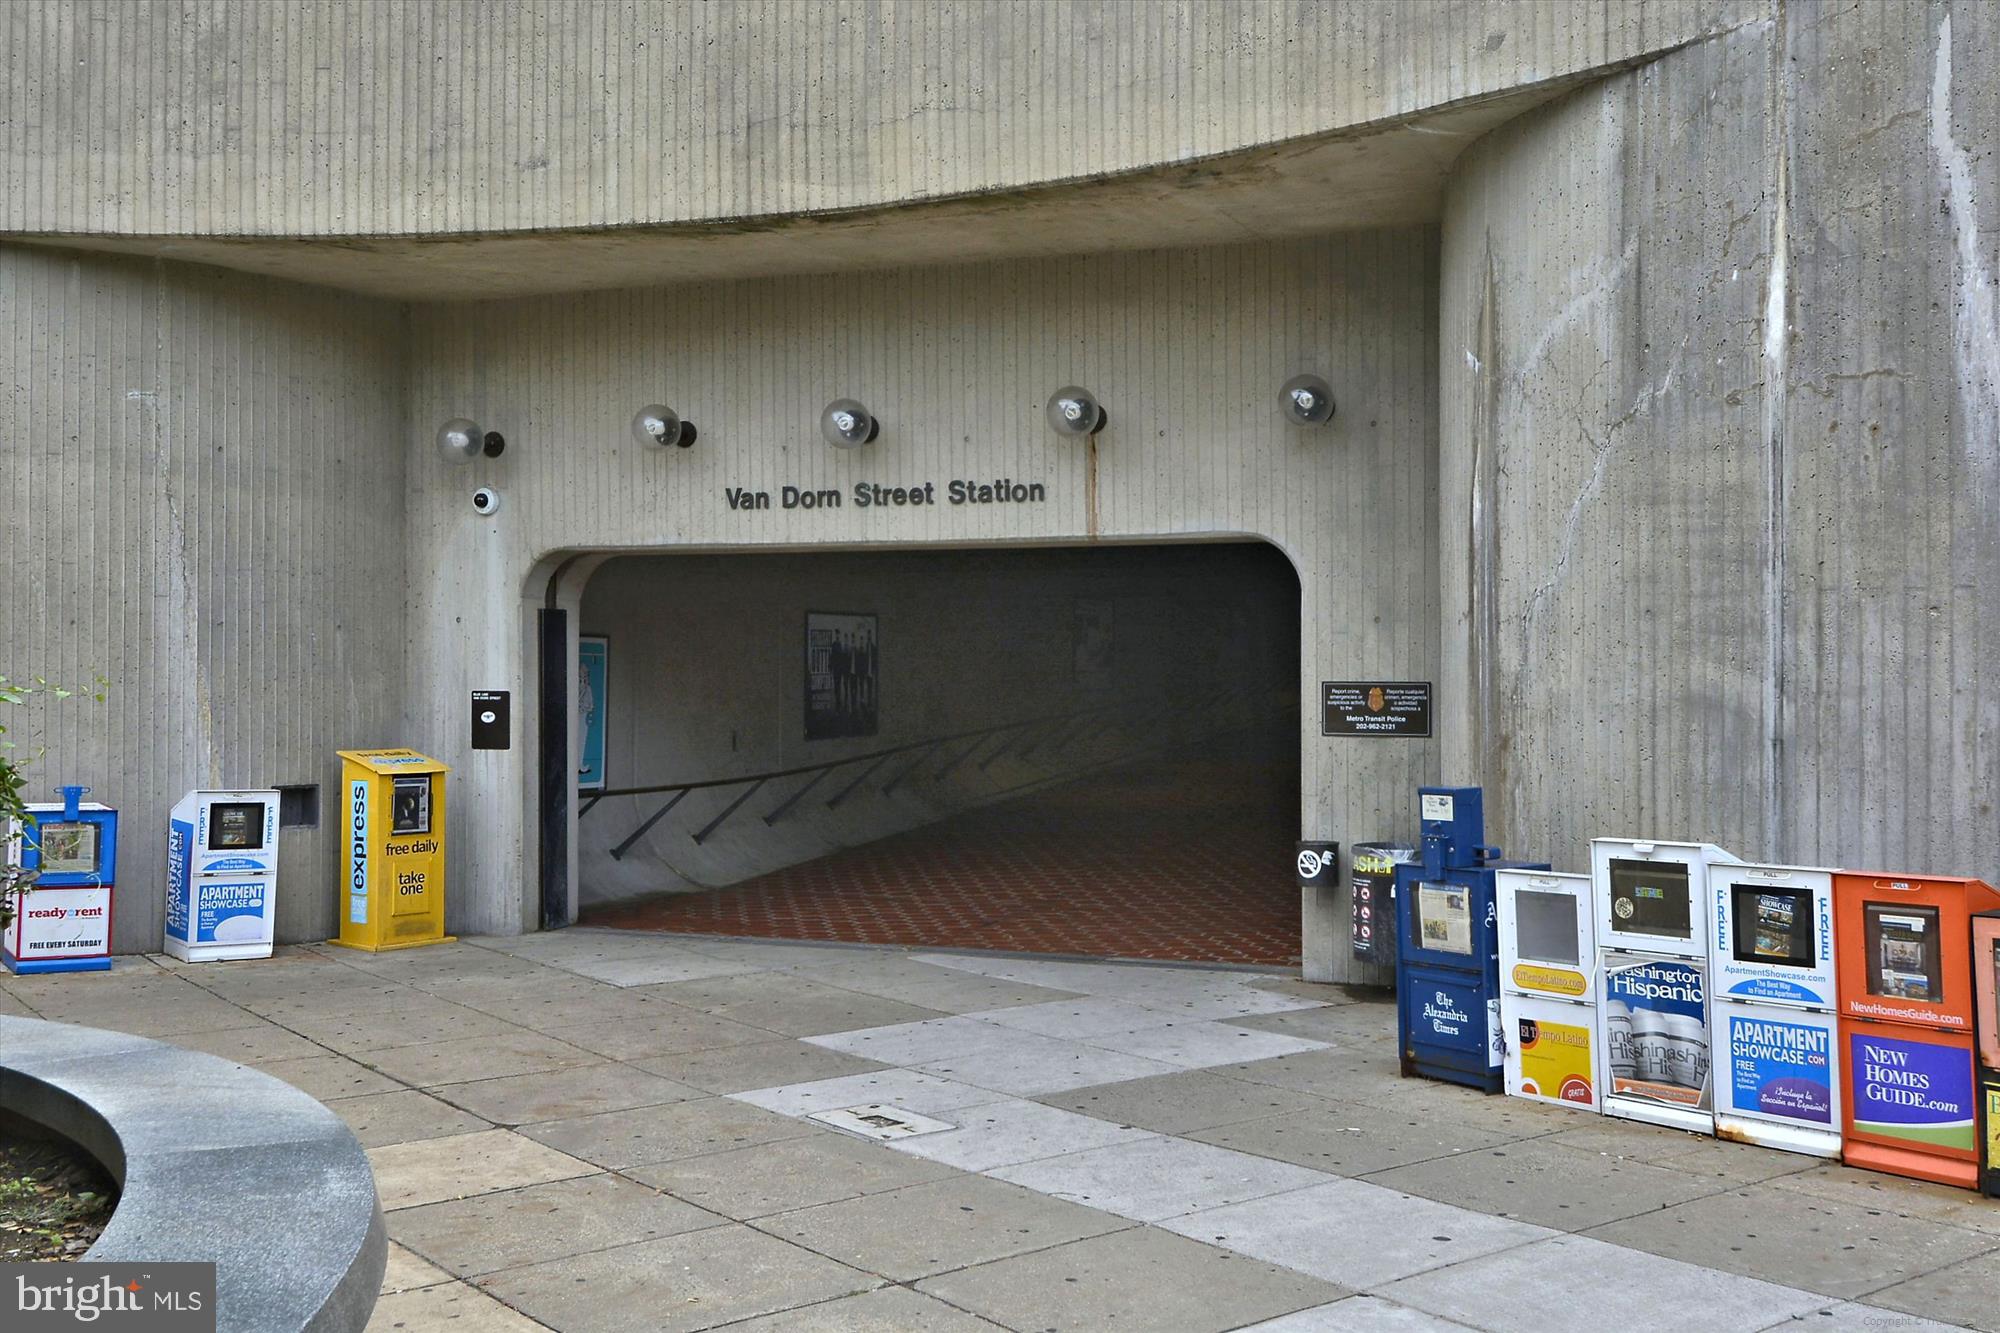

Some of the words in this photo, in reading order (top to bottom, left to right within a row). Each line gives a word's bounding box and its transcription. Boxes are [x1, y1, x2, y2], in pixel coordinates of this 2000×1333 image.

[725, 487, 769, 509] Van
[782, 486, 841, 509] Dorn
[854, 482, 934, 507] Street
[948, 479, 1045, 505] Station
[266, 806, 274, 844] FREE
[354, 786, 366, 890] express
[386, 842, 410, 856] free
[412, 839, 438, 854] daily
[167, 827, 180, 927] APARTMENT
[399, 870, 425, 884] take
[201, 886, 264, 900] APARTMENT
[400, 884, 424, 896] one
[200, 899, 248, 910] SHOWCASE
[1760, 898, 1792, 912] SHOWCASE
[1717, 890, 1726, 950] FREE
[1818, 898, 1829, 960] FREE
[30, 941, 45, 950] FREE
[68, 940, 102, 948] SATURDAY
[1619, 966, 1703, 984] ashington
[1725, 965, 1826, 983] ApartmentShowcase.com
[1614, 976, 1704, 1003] Hispanic
[1436, 991, 1454, 1010] The
[1422, 1002, 1468, 1023] Alexandria
[1850, 1001, 1964, 1024] NewHomesGuide.com
[1432, 1018, 1458, 1035] Times
[1520, 1026, 1530, 1038] El
[1562, 1032, 1588, 1046] Latino
[1733, 1020, 1827, 1052] APARTMENT
[1736, 1060, 1755, 1070] FREE
[1805, 1090, 1812, 1100] la
